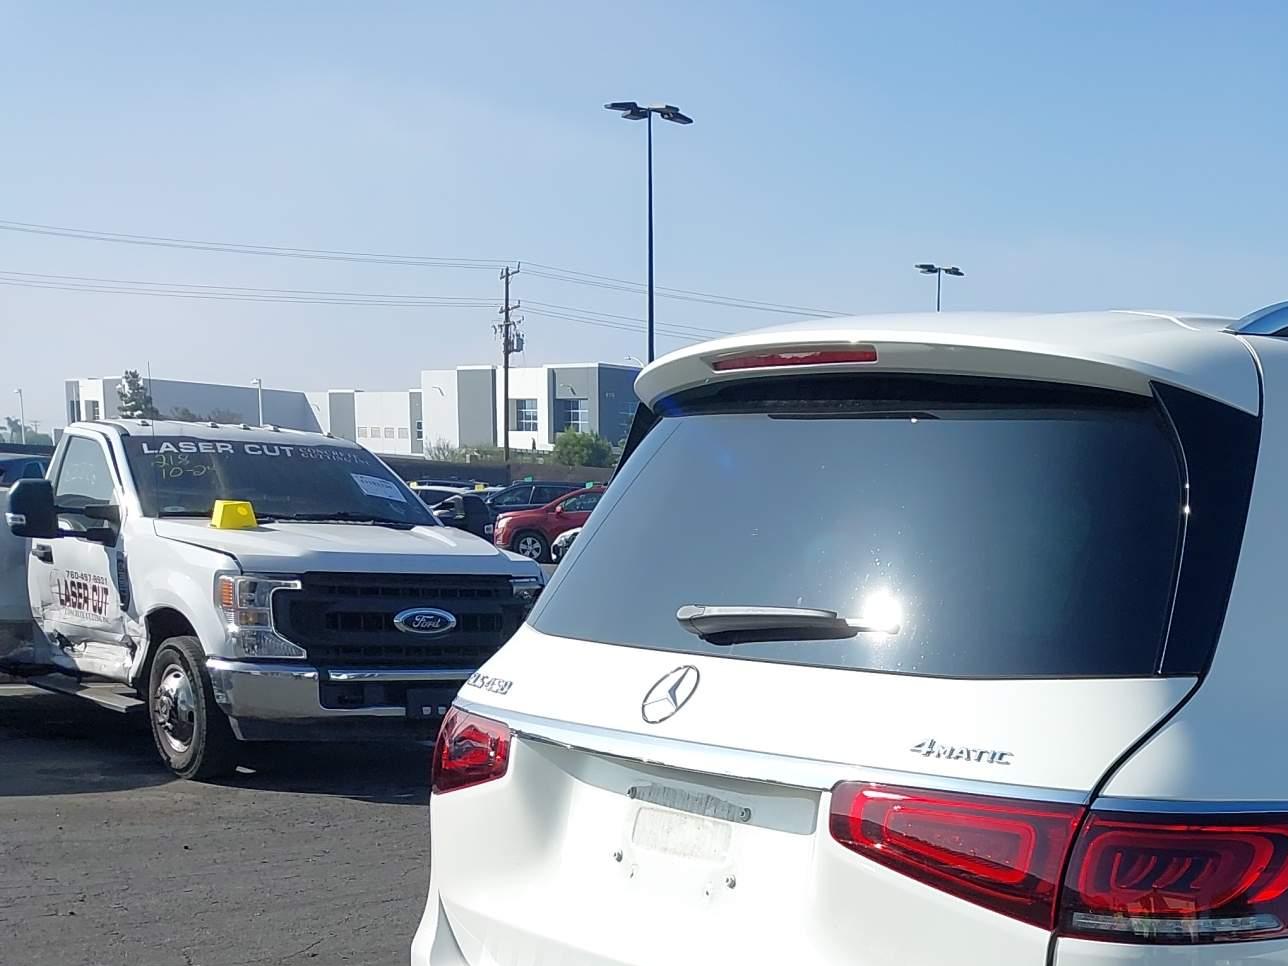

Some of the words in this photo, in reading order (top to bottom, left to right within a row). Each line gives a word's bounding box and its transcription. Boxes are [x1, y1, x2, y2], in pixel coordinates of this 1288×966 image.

[142, 441, 234, 454] LASER
[244, 444, 294, 457] CUT
[57, 578, 89, 612] LASER
[92, 584, 109, 616] CUT
[412, 615, 441, 629] Ford
[910, 739, 1015, 765] 4MATIC
